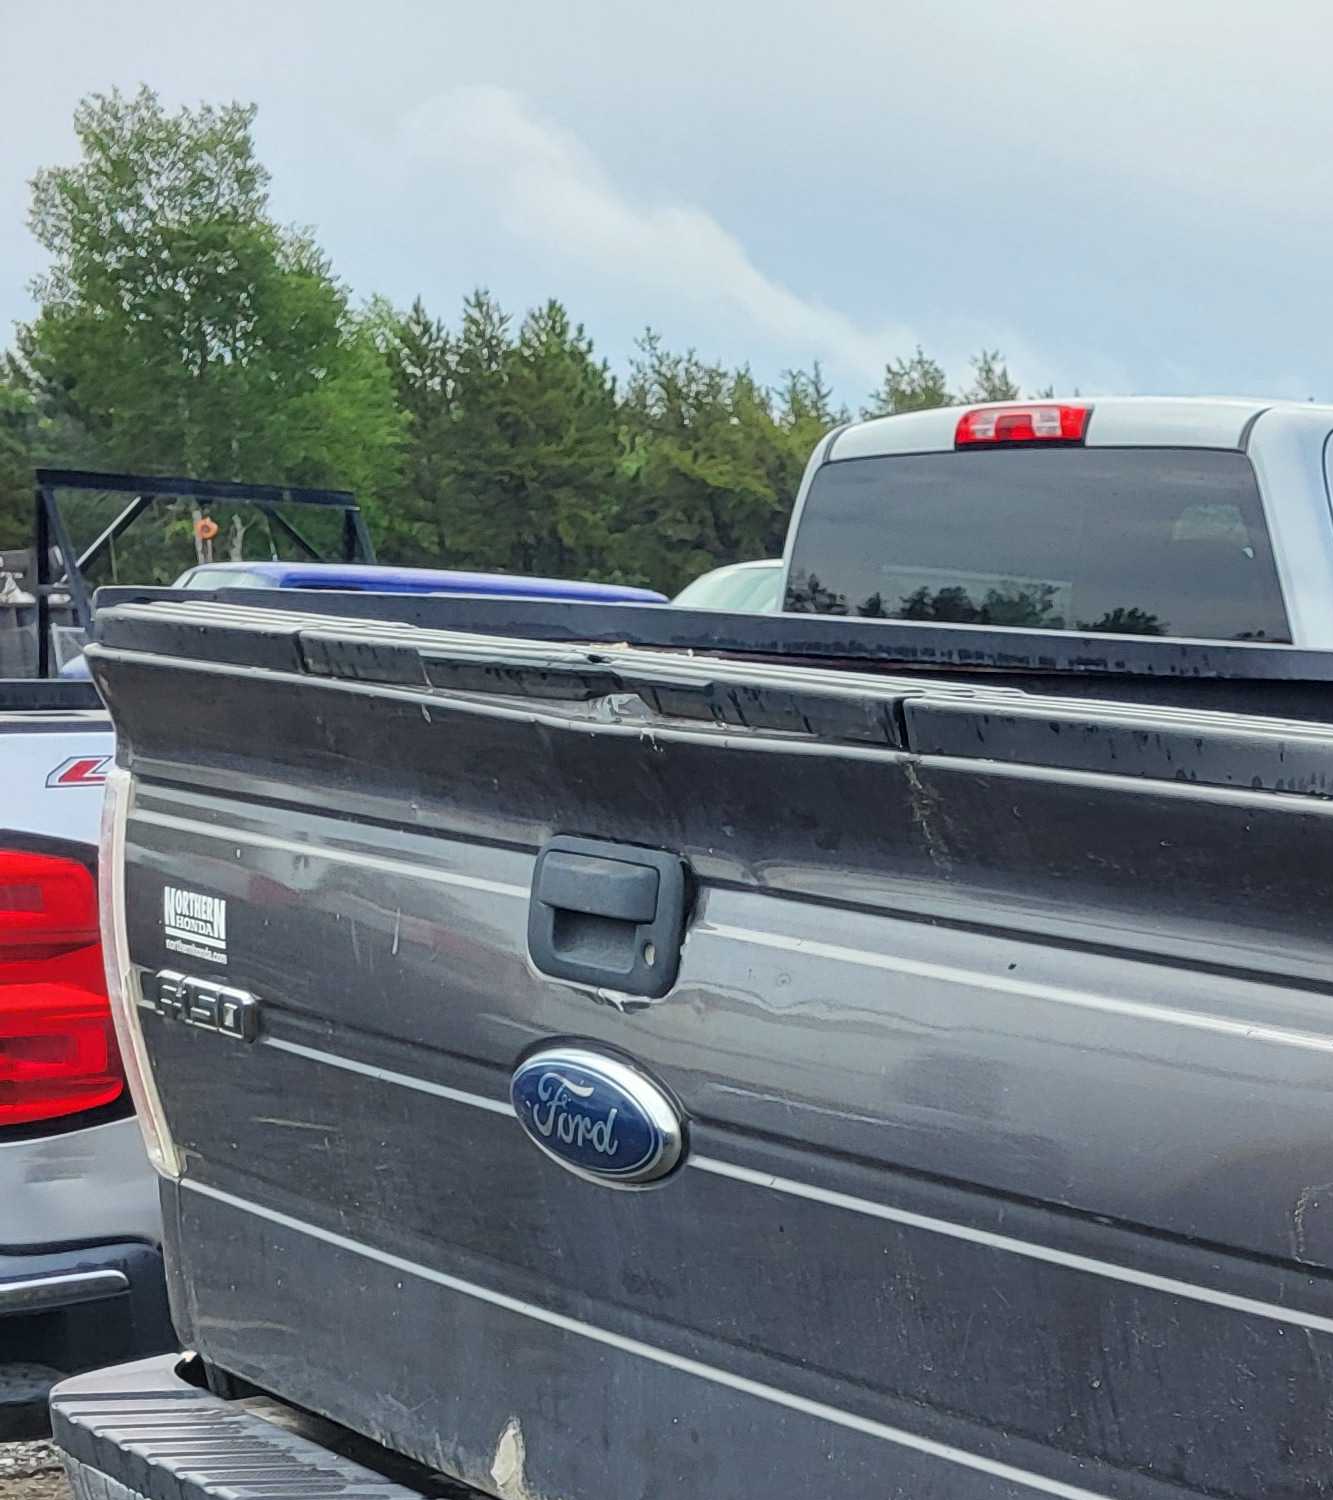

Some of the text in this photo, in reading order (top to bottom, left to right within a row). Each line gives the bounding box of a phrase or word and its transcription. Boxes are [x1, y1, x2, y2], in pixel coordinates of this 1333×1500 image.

[164, 885, 226, 939] NORTHERN
[176, 914, 214, 937] HONDA
[532, 1072, 619, 1156] Ford
